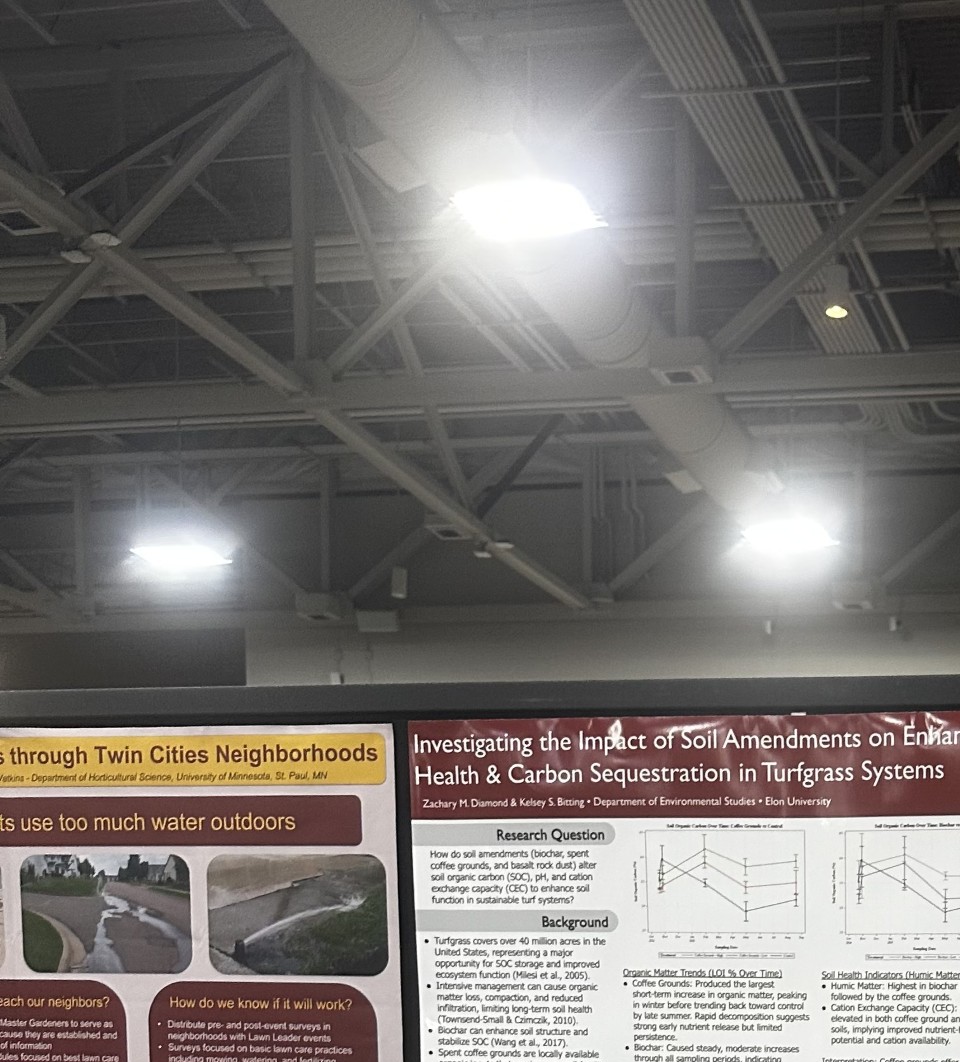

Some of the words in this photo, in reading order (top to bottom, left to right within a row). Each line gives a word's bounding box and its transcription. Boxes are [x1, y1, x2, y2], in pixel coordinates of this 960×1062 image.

[414, 733, 533, 758] Investigating
[539, 731, 572, 751] the
[579, 730, 648, 757] Impact
[653, 730, 675, 749] of
[681, 728, 718, 749] Soil
[722, 729, 861, 749] Amendments
[869, 731, 896, 747] on
[10, 746, 88, 769] through
[94, 746, 143, 764] Twin
[150, 745, 209, 764] Cities
[216, 743, 378, 767] Neighborhoods
[415, 765, 479, 786] Health
[486, 765, 501, 784] &
[508, 764, 583, 784] Carbon
[590, 763, 731, 788] Sequestration
[740, 763, 756, 782] in
[761, 762, 854, 786] Turfgrass
[862, 760, 944, 786] Systems
[423, 799, 457, 810] Zachary
[459, 799, 470, 808] M.
[471, 798, 508, 808] Diamond
[510, 798, 517, 807] &
[520, 798, 546, 809] Kelsey
[548, 797, 556, 807] S.
[557, 797, 585, 809] Bitting
[593, 797, 646, 808] Department
[648, 796, 658, 806] of
[660, 796, 722, 806] Environmental
[724, 796, 756, 806] Studies
[765, 796, 785, 806] Elon
[787, 797, 832, 808] University
[21, 818, 53, 832] use
[59, 814, 88, 831] too
[94, 813, 145, 831] much
[151, 813, 206, 831] water
[211, 812, 296, 831] outdoors
[497, 829, 548, 841] Research
[551, 828, 605, 843] Question
[430, 851, 449, 859] How
[451, 850, 462, 859] do
[463, 850, 476, 859] soil
[478, 850, 529, 859] amendments
[531, 849, 565, 860] (biochar,
[567, 850, 590, 859] spent
[542, 916, 609, 931] Background
[623, 968, 652, 978] Organic
[654, 969, 678, 978] Matter
[680, 969, 707, 979] Trends
[708, 969, 726, 979] (LOI
[728, 969, 737, 979] %
[739, 969, 758, 979] Over
[760, 970, 783, 979] Time)
[822, 971, 836, 980] Soil
[838, 971, 863, 981] Health
[865, 971, 903, 981] Indicators
[905, 971, 934, 981] (Humic
[27, 998, 45, 1008] our
[48, 996, 110, 1010] neighbors?
[170, 996, 196, 1008] How
[199, 997, 214, 1009] do
[217, 1000, 235, 1009] we
[238, 998, 270, 1010] know
[273, 998, 280, 1009] if
[284, 999, 291, 1010] it
[294, 999, 313, 1010] will
[316, 999, 352, 1011] work?
